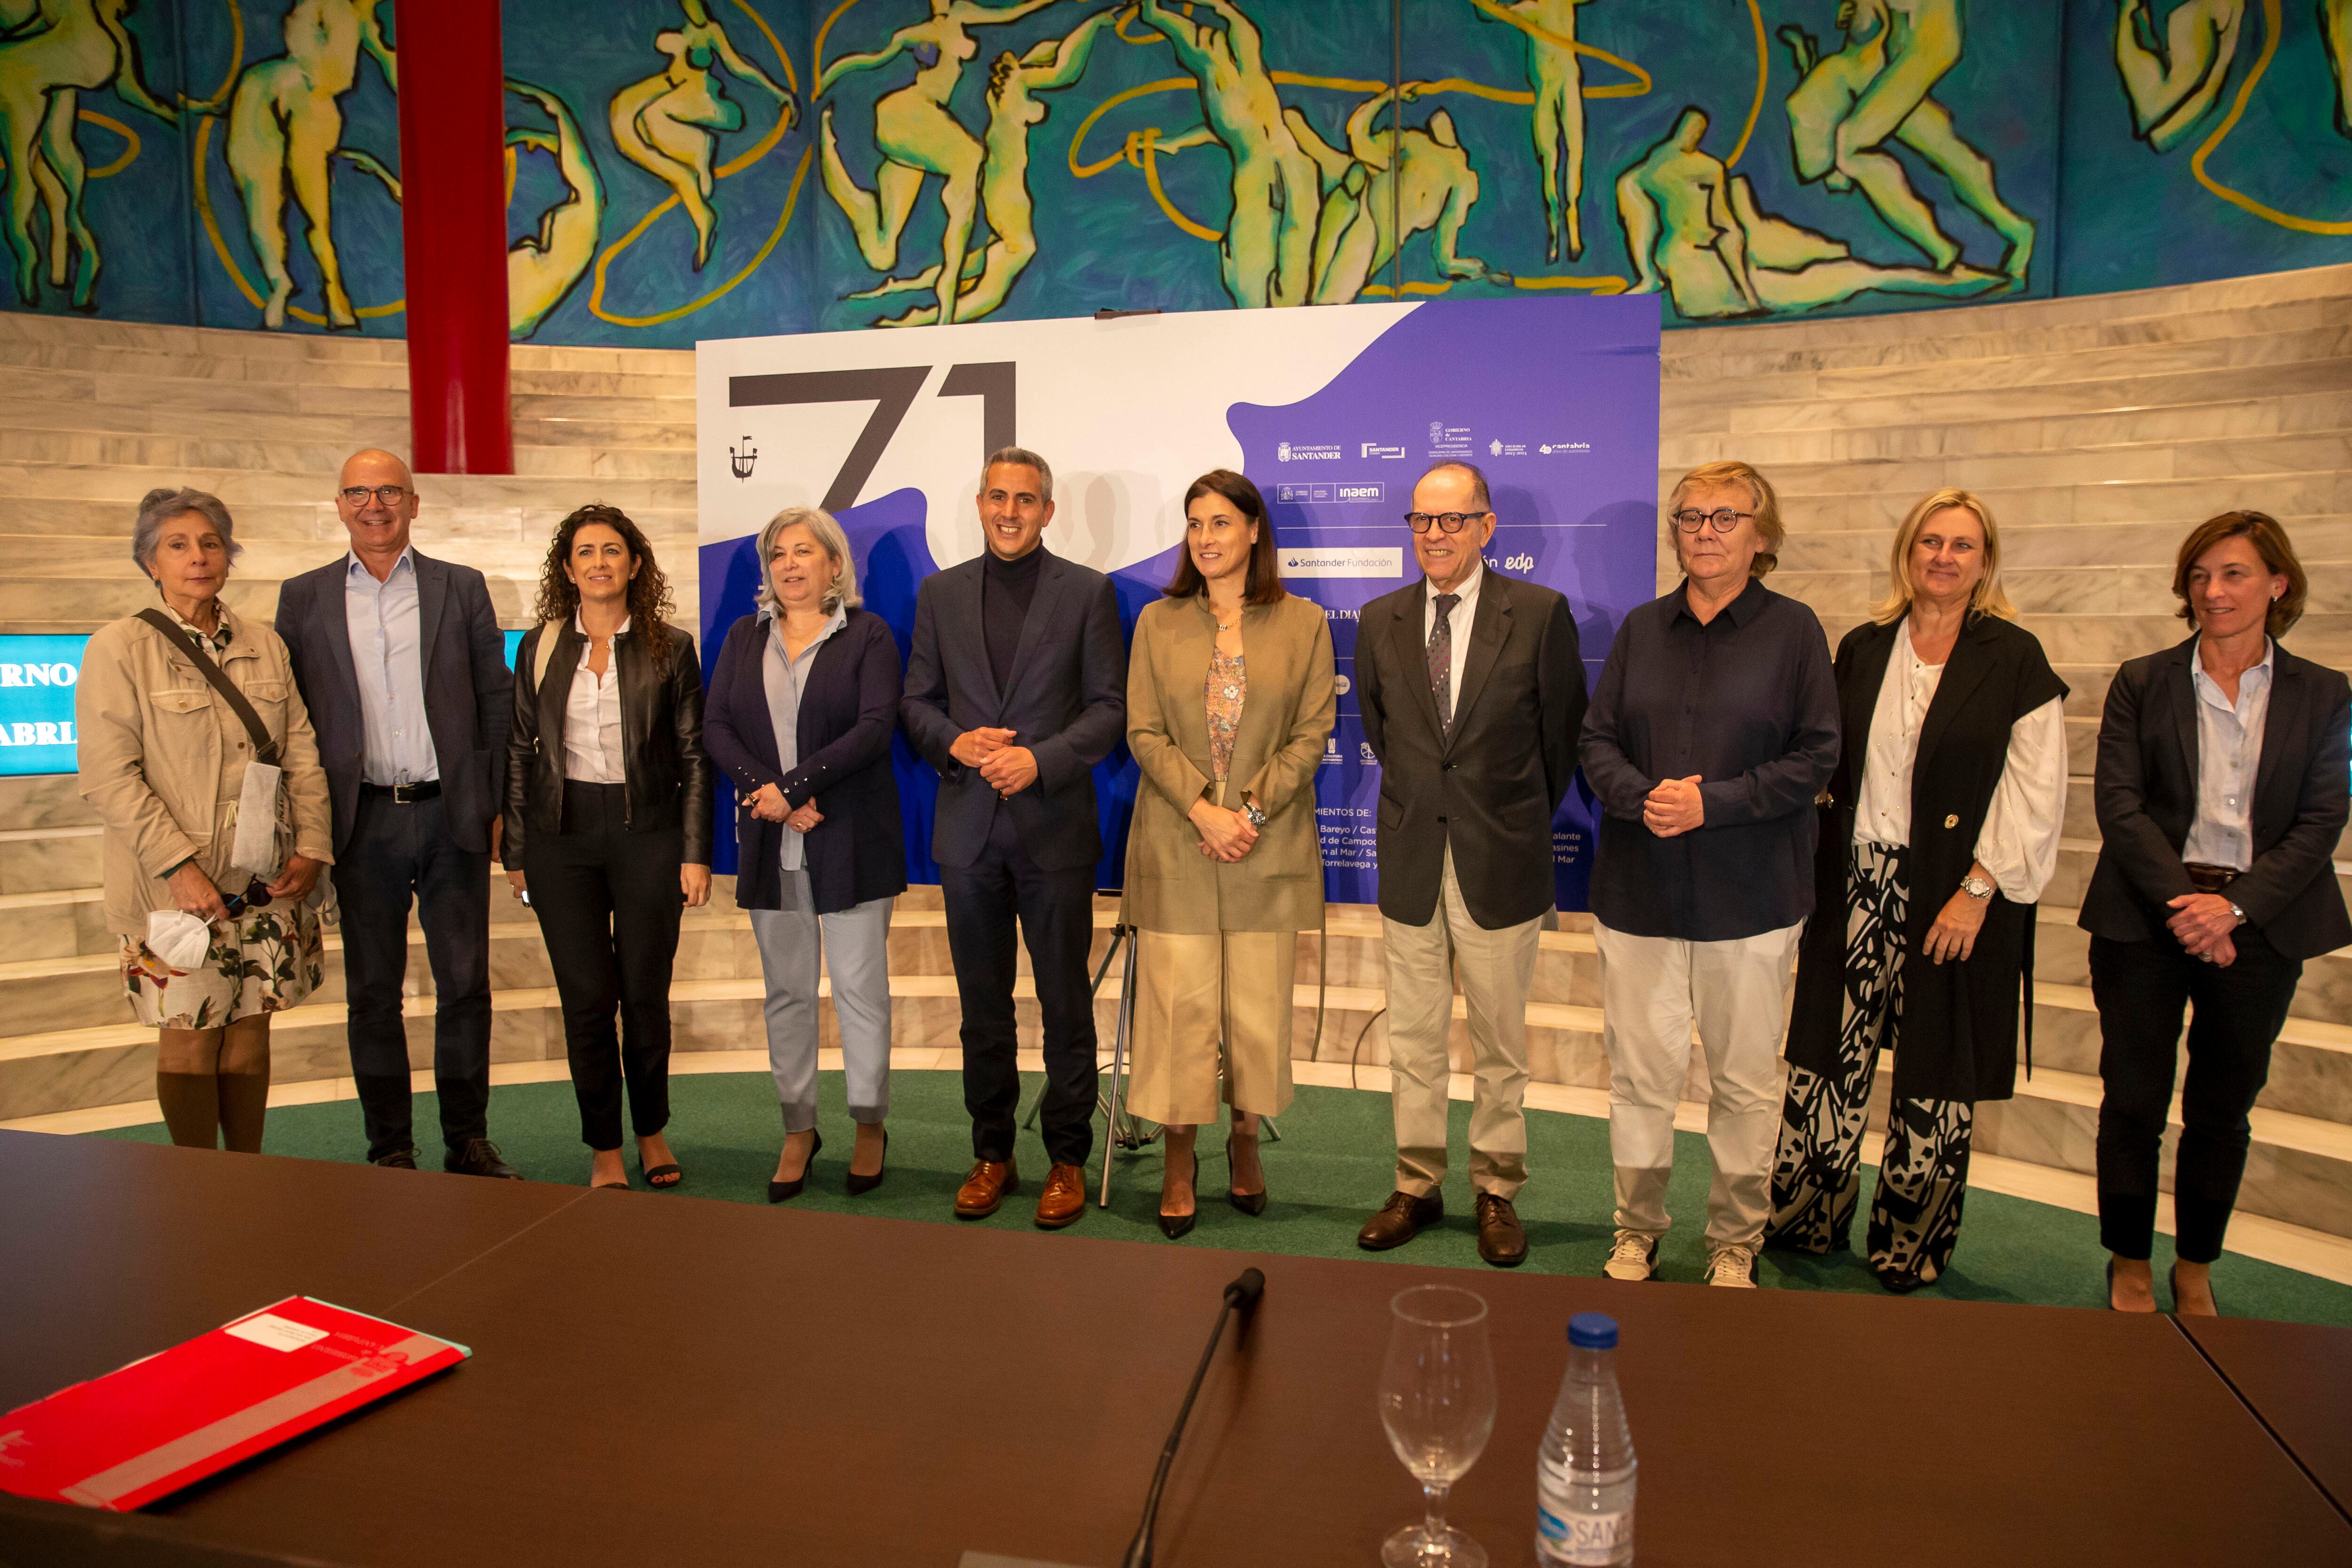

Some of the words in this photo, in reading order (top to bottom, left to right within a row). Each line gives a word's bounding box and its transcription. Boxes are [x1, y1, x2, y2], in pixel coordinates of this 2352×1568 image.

[729, 361, 1016, 514] 71
[1340, 487, 1379, 497] inaem
[1300, 559, 1345, 567] Santander
[1347, 558, 1392, 567] Fundación
[1504, 552, 1534, 574] edp
[1325, 610, 1338, 619] EL
[1320, 825, 1351, 835] Bareyo
[1322, 859, 1371, 869] Torrelavega
